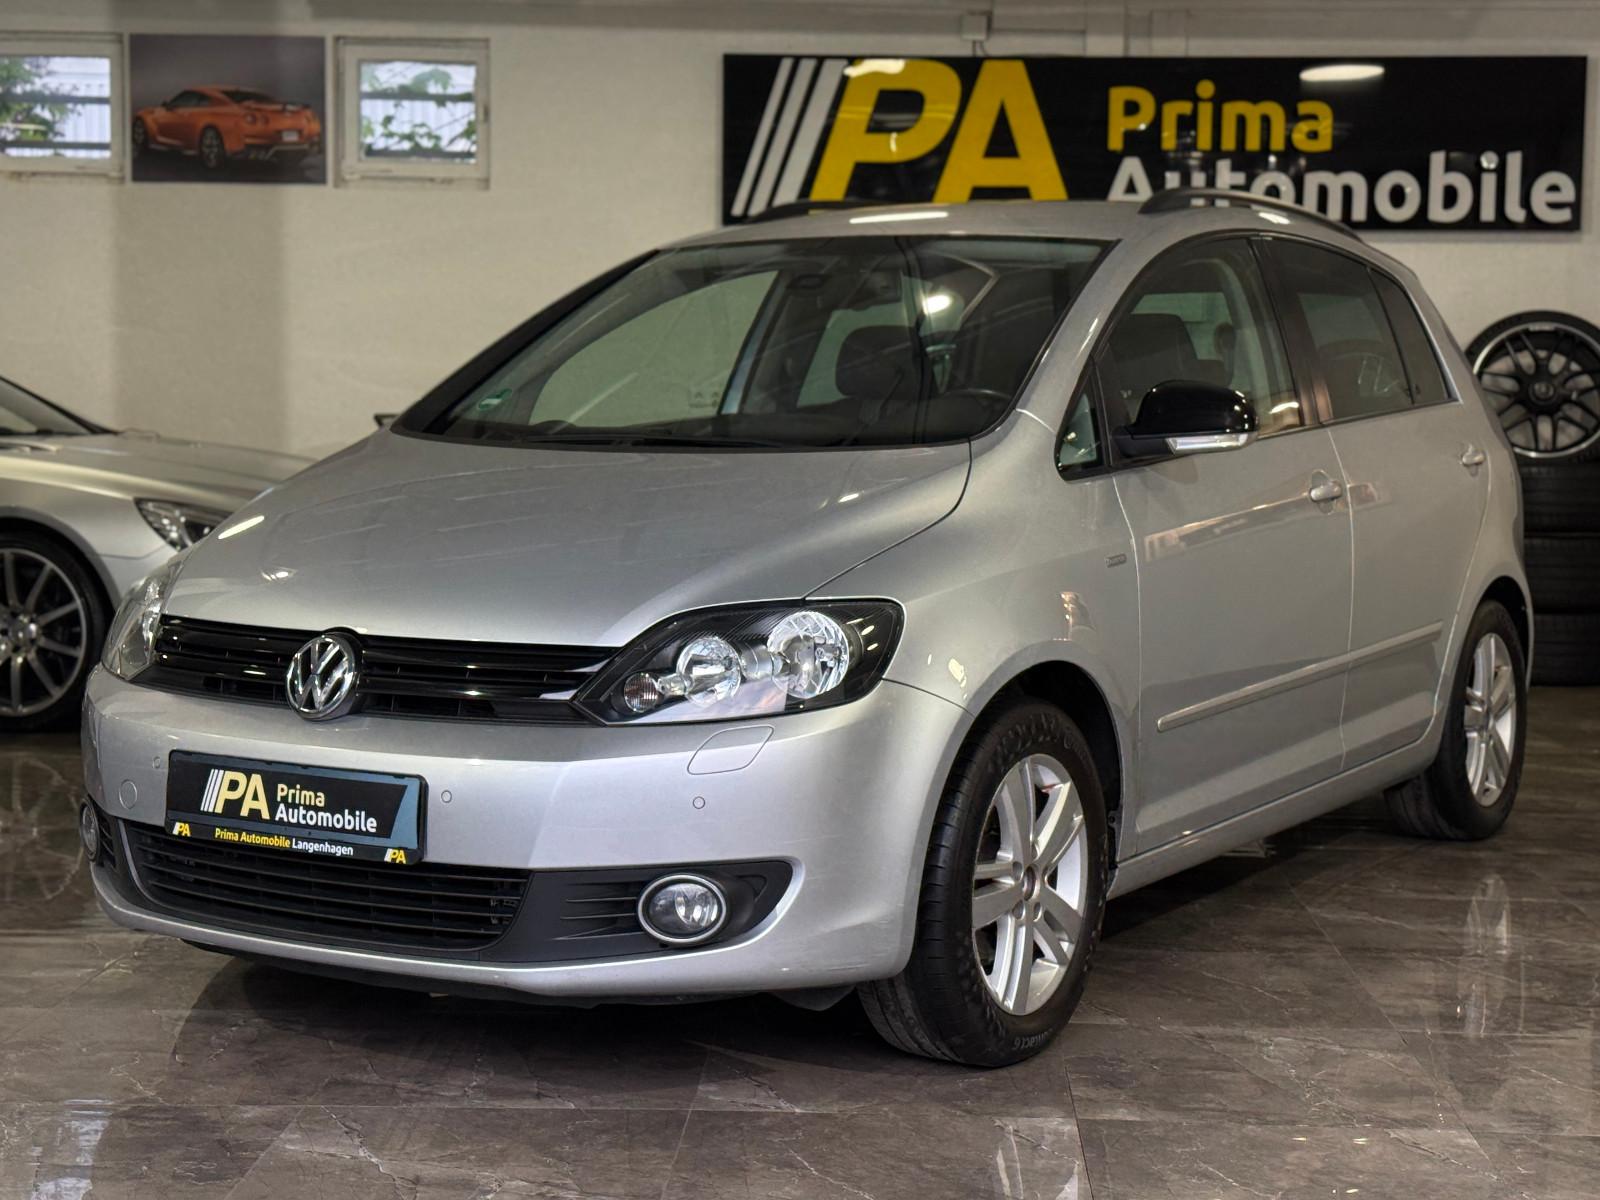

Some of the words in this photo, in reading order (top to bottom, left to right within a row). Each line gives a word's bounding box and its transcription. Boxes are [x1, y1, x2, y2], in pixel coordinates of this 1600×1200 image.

[1107, 79, 1334, 153] Prima
[808, 59, 1069, 204] PA
[214, 770, 271, 820] PA
[276, 783, 325, 807] Prima
[176, 822, 191, 837] PA
[275, 803, 378, 833] Automobile
[215, 828, 239, 842] Prima
[240, 831, 291, 848] Automobile
[292, 838, 354, 856] Langenhagen
[389, 849, 407, 865] PA
